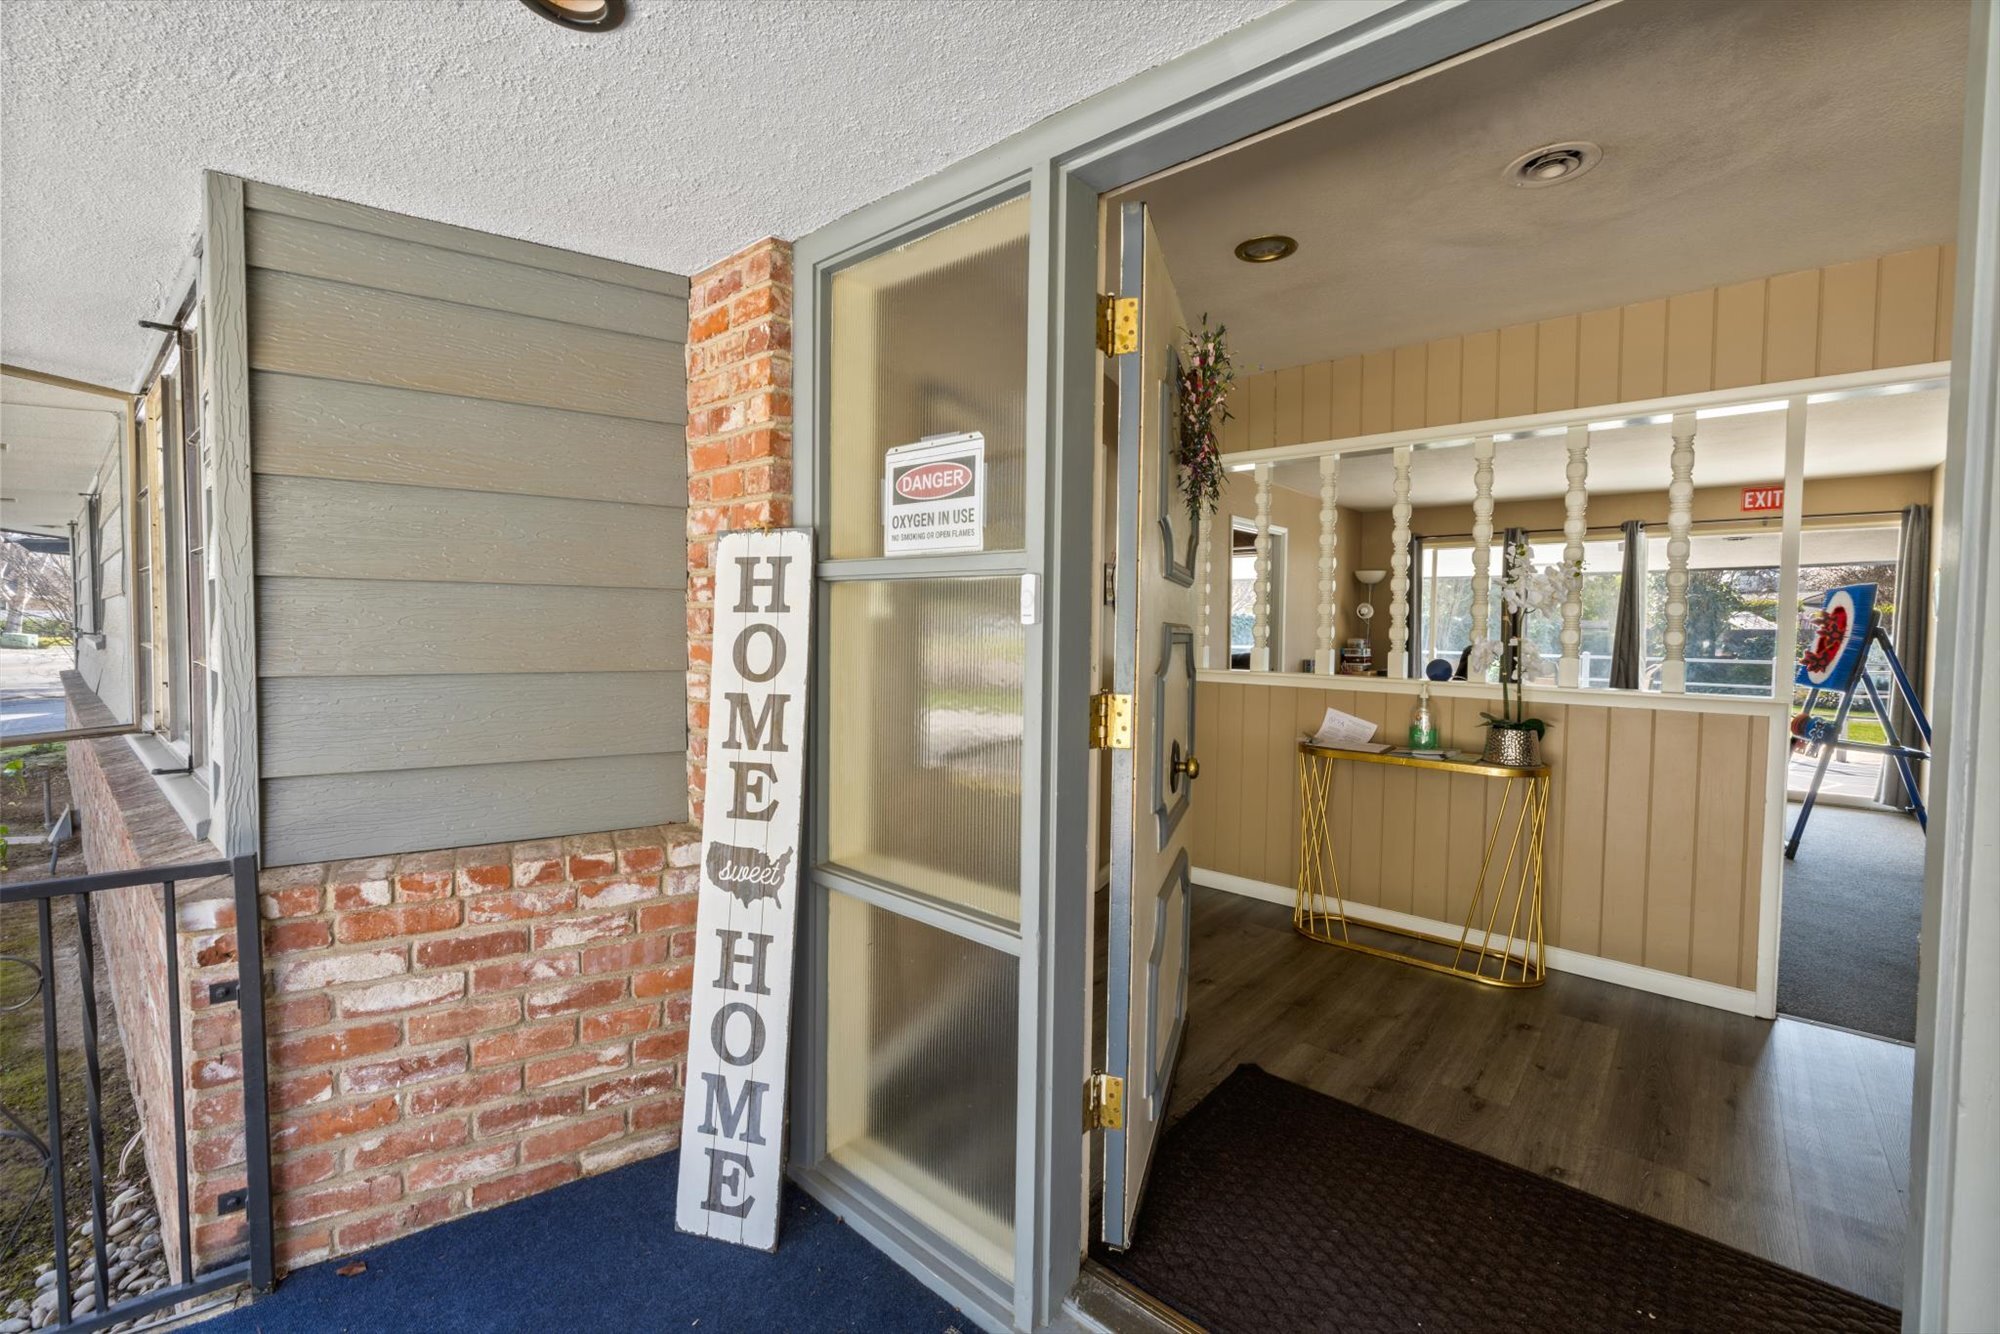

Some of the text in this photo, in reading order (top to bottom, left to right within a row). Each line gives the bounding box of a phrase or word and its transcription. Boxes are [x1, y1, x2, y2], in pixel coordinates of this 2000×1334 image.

[902, 469, 964, 492] DANGER
[1744, 489, 1783, 509] EXIT
[892, 507, 975, 529] OXYGEN IN USE
[891, 528, 975, 542] NO SMOKING OR OPEN FLAMES
[722, 556, 792, 822] HOME
[719, 860, 781, 885] sweet
[697, 928, 774, 1219] HOME
